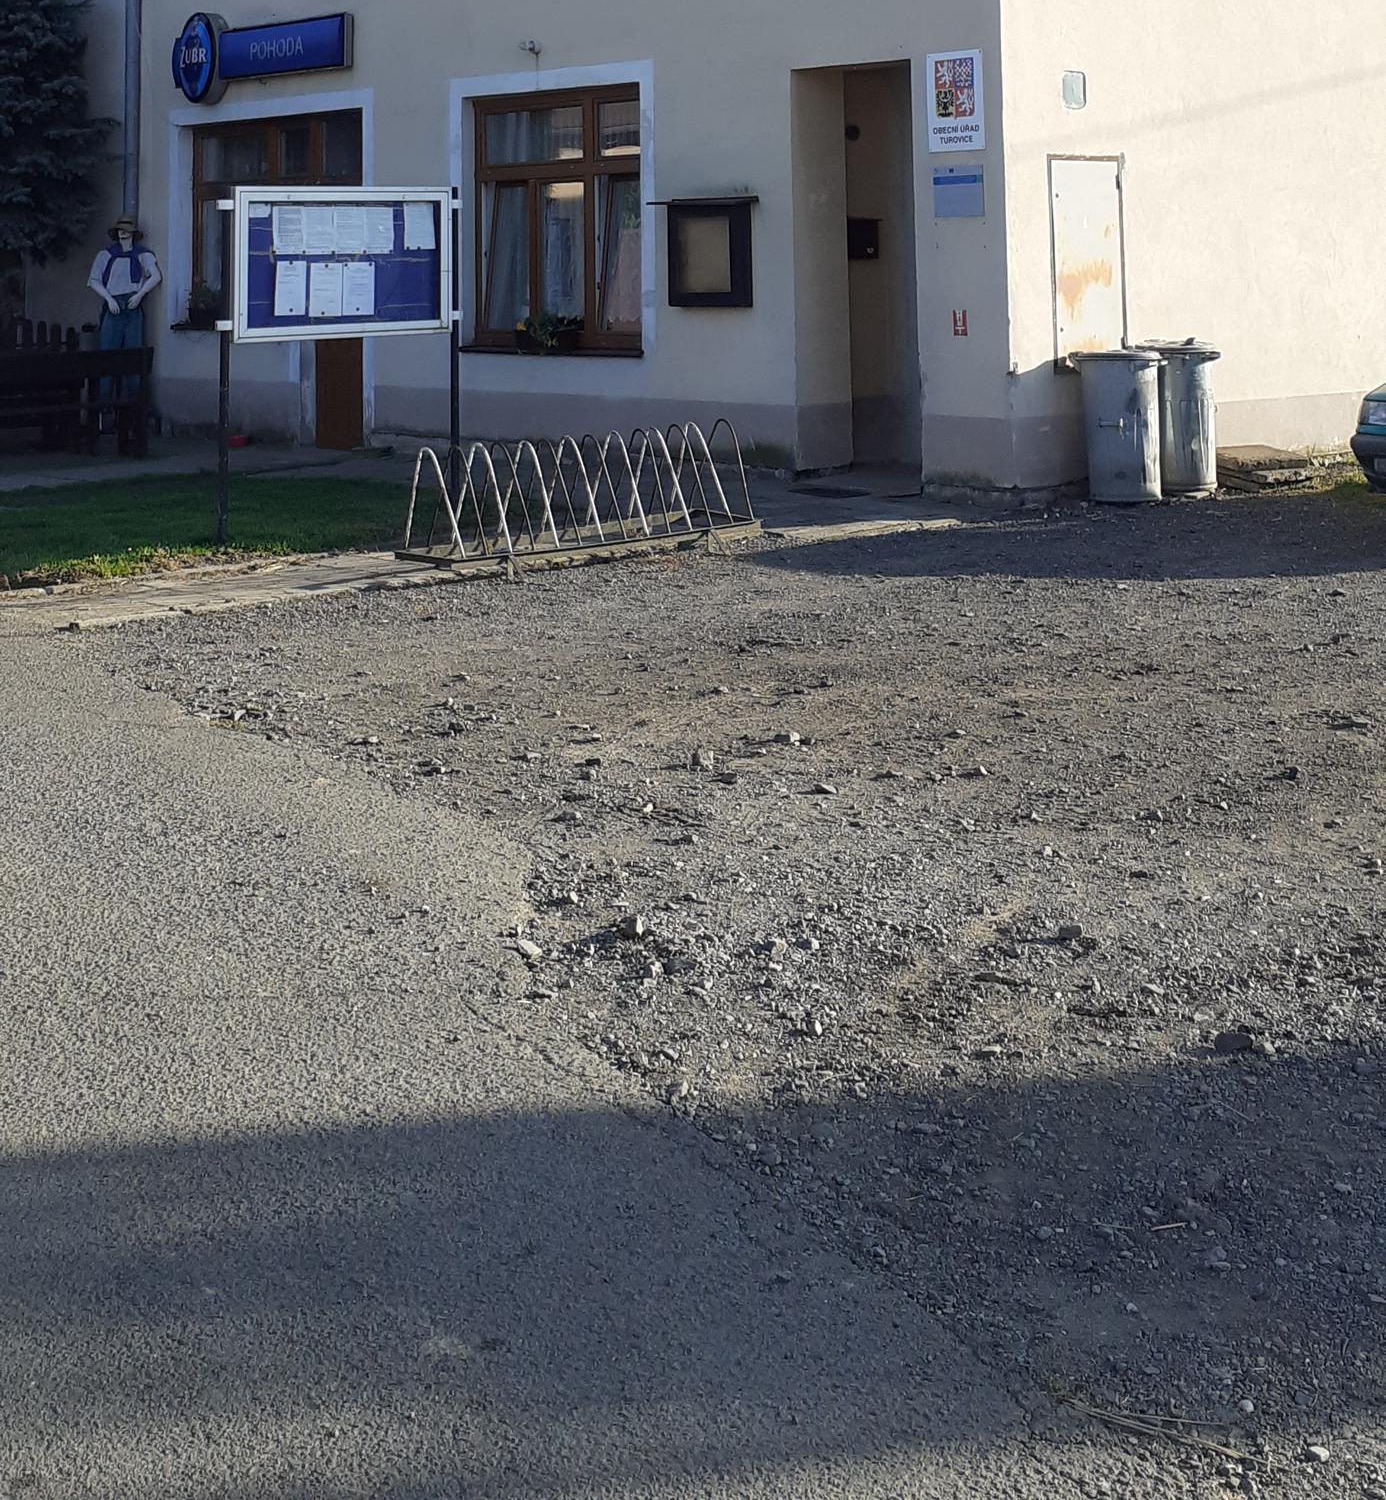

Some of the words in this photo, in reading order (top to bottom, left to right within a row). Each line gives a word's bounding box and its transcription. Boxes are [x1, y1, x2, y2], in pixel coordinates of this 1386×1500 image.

[249, 36, 304, 60] POHODA
[179, 46, 207, 68] ZUBR
[933, 124, 959, 135] OBECNÍ
[960, 123, 980, 133] ÚŘAD
[939, 135, 973, 145] TUROVICE
